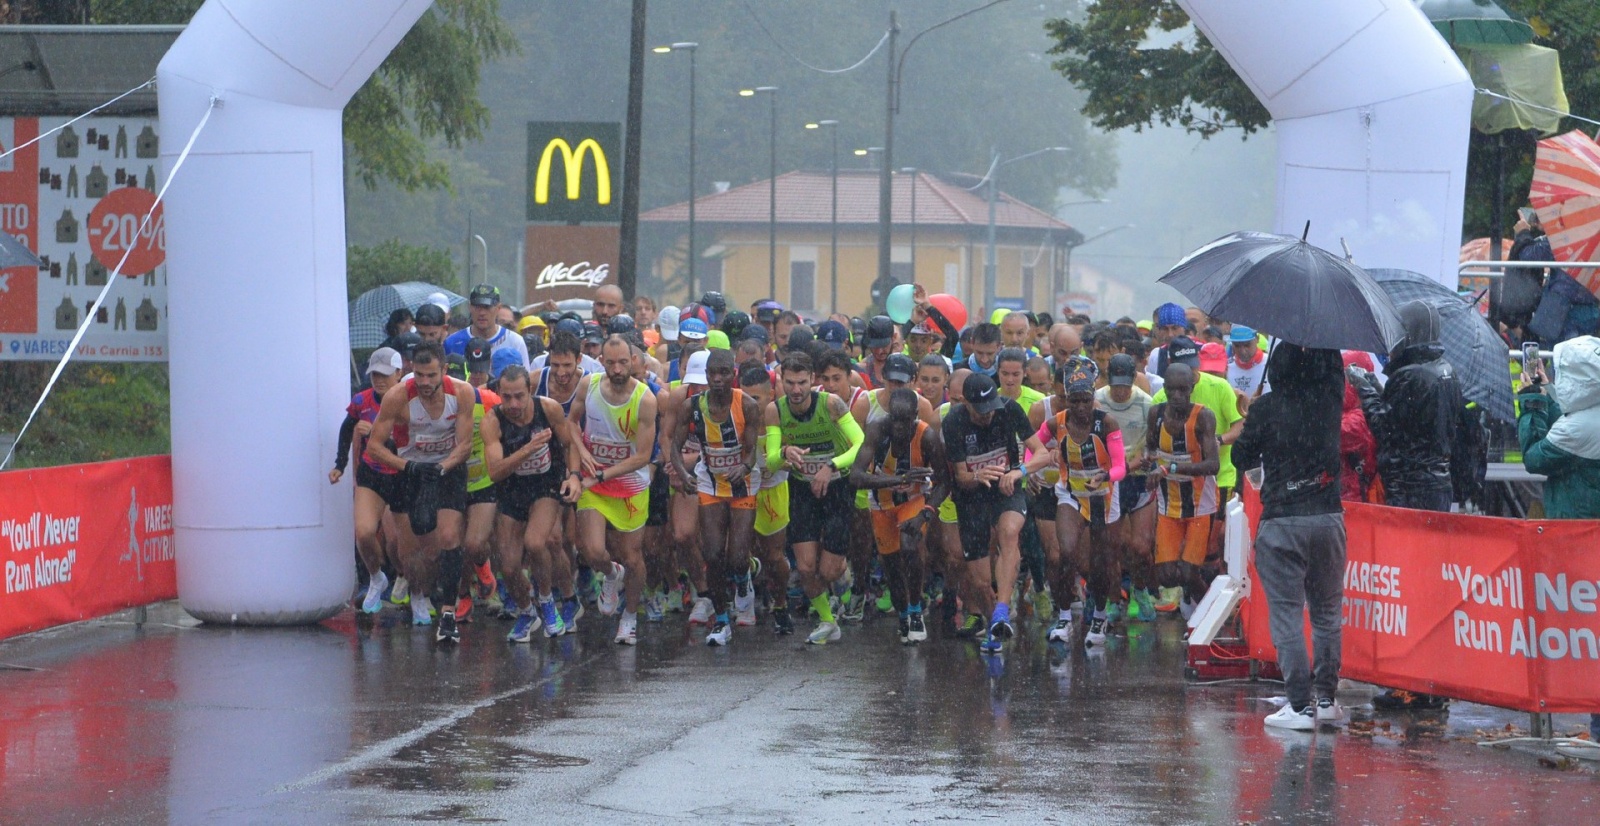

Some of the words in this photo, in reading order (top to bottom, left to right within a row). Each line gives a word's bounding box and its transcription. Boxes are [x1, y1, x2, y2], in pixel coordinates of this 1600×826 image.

[0, 204, 29, 229] TO
[90, 213, 165, 251] -20%
[1175, 348, 1196, 356] adidas
[518, 453, 550, 470] 004
[591, 444, 628, 459] 1043
[709, 454, 741, 467] 1001
[43, 513, 81, 546] Never
[5, 560, 33, 594] Run
[1454, 610, 1502, 653] Run
[1510, 616, 1600, 660] Alon
